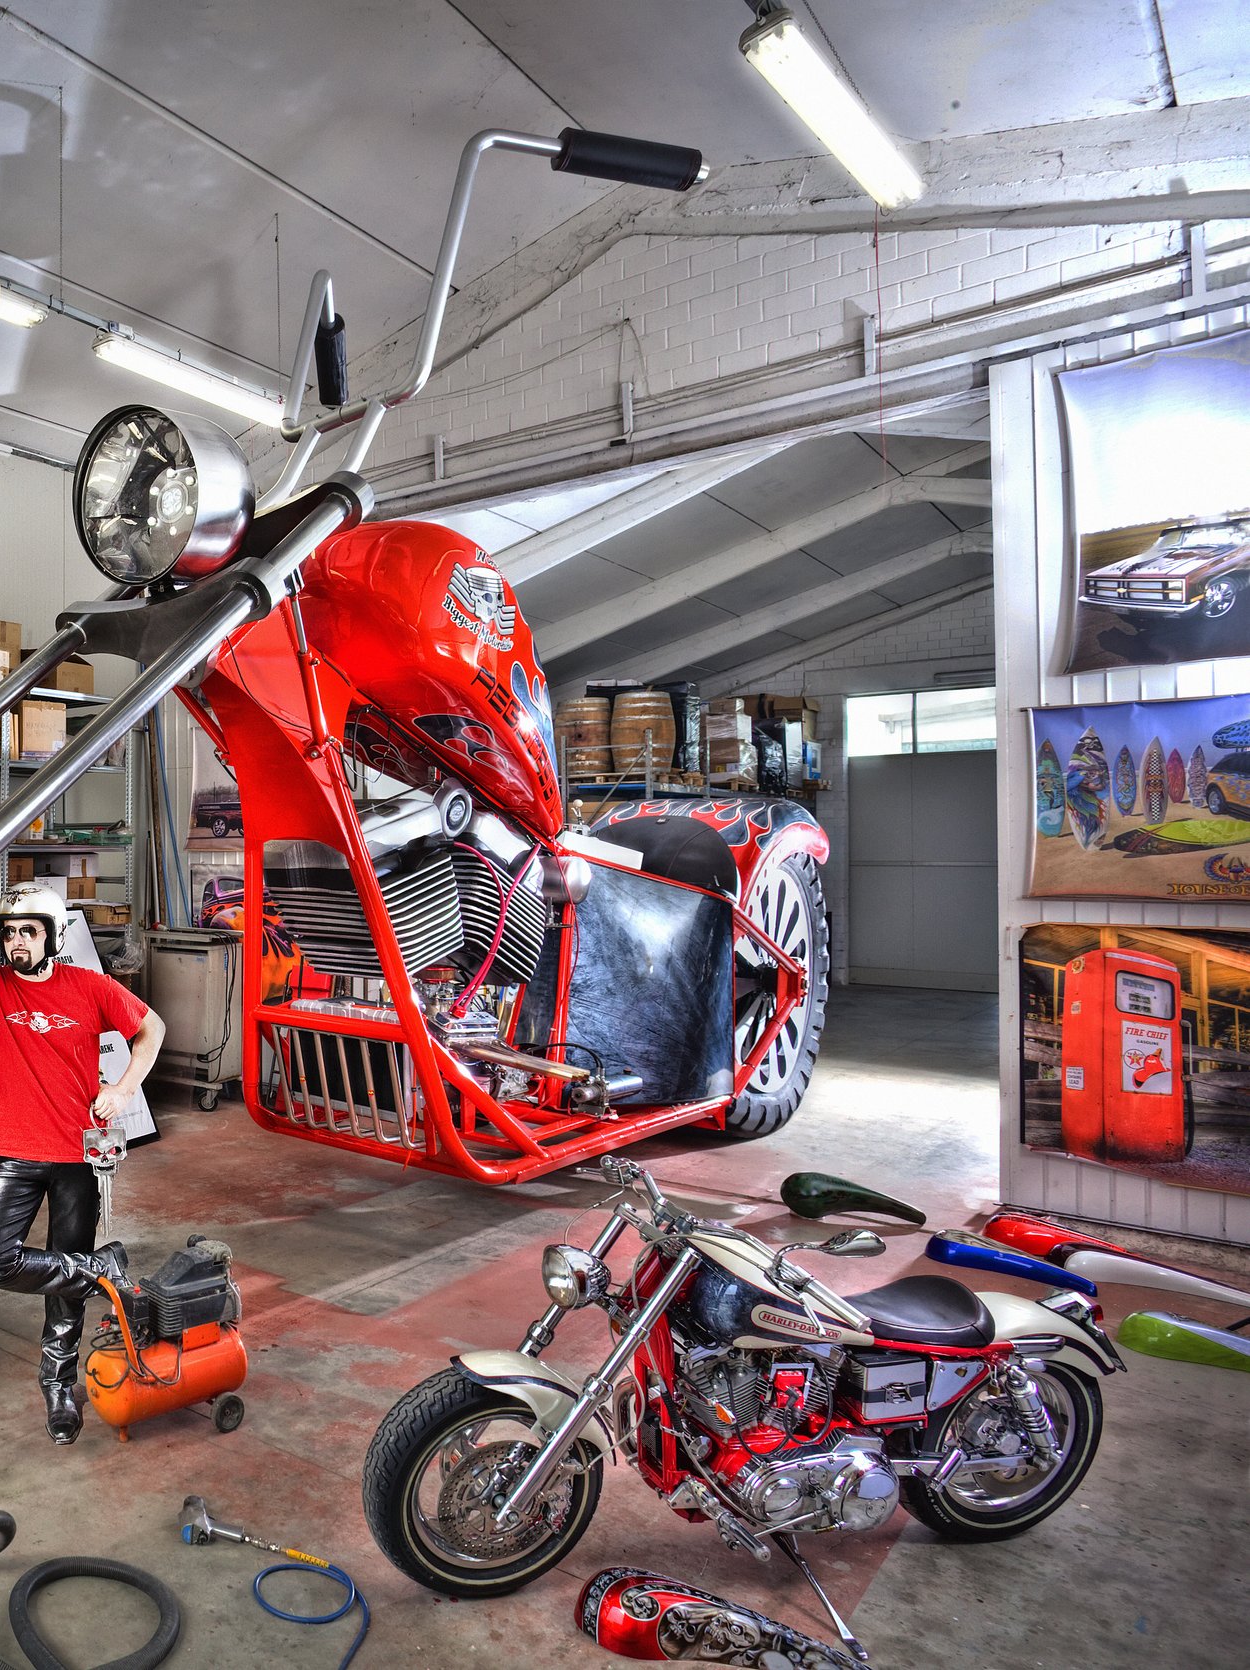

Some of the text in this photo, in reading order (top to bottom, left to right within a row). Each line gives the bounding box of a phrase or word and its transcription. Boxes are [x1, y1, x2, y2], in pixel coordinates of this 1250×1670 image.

[442, 593, 481, 633] Biggest
[1125, 1027, 1169, 1040] FIRE CHIEF
[762, 1313, 840, 1339] HARLEY-DAVSON
